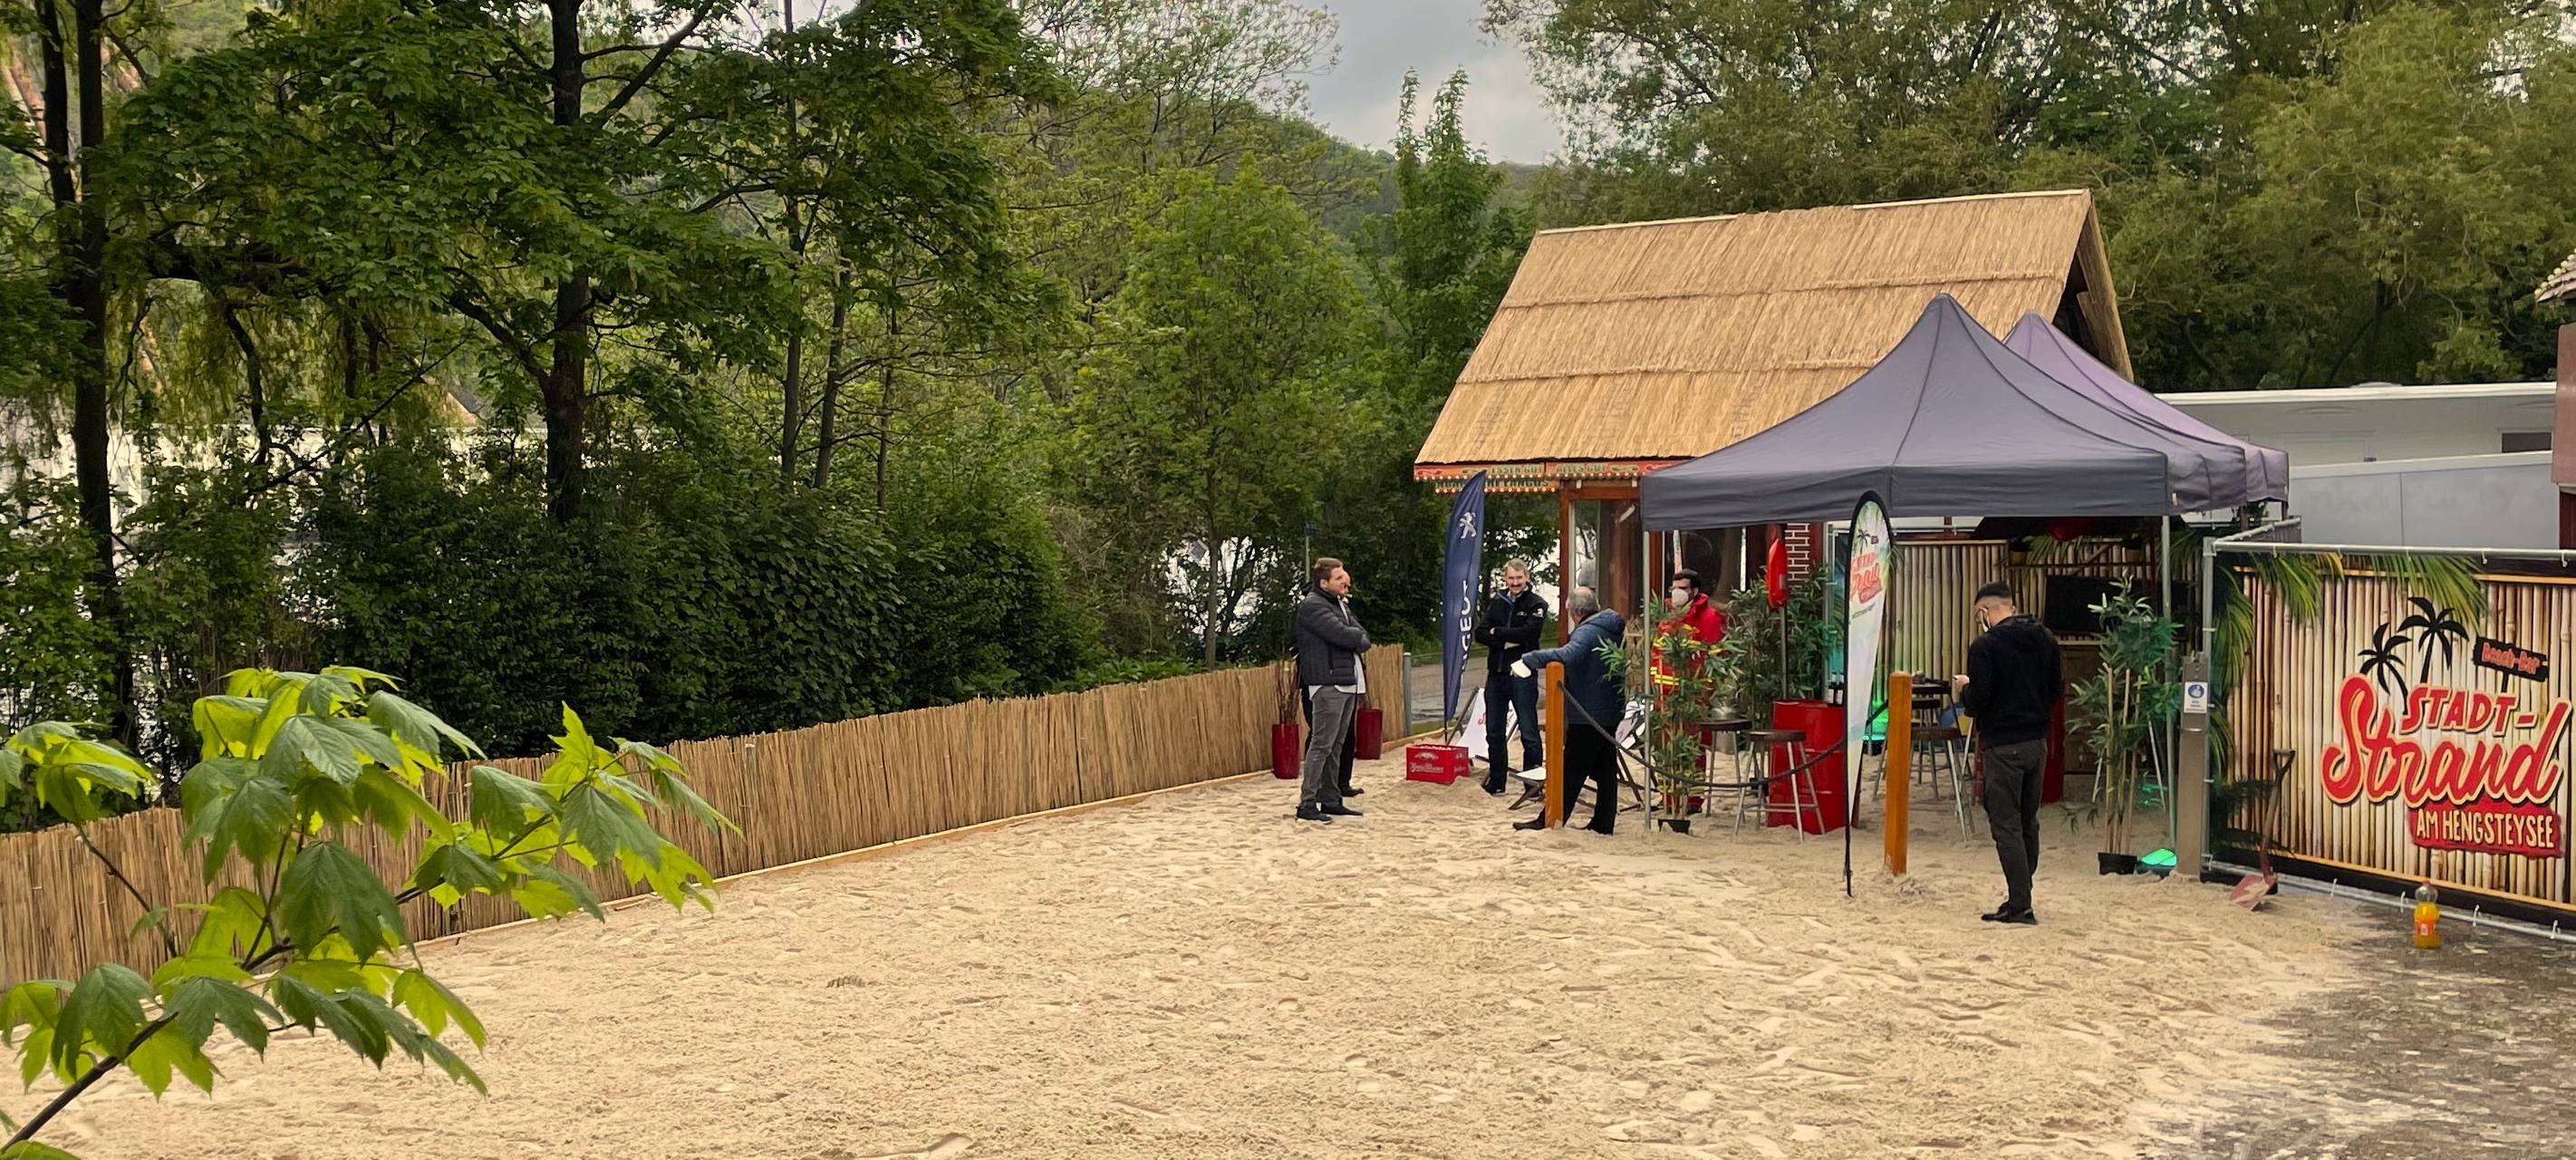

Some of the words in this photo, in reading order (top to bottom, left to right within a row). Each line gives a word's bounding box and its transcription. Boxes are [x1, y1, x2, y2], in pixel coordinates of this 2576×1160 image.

[2401, 685, 2536, 735] STADT-
[2321, 673, 2571, 807] Strand
[2417, 808, 2439, 840] AM
[2442, 809, 2554, 848] HENGSTEYSEE
